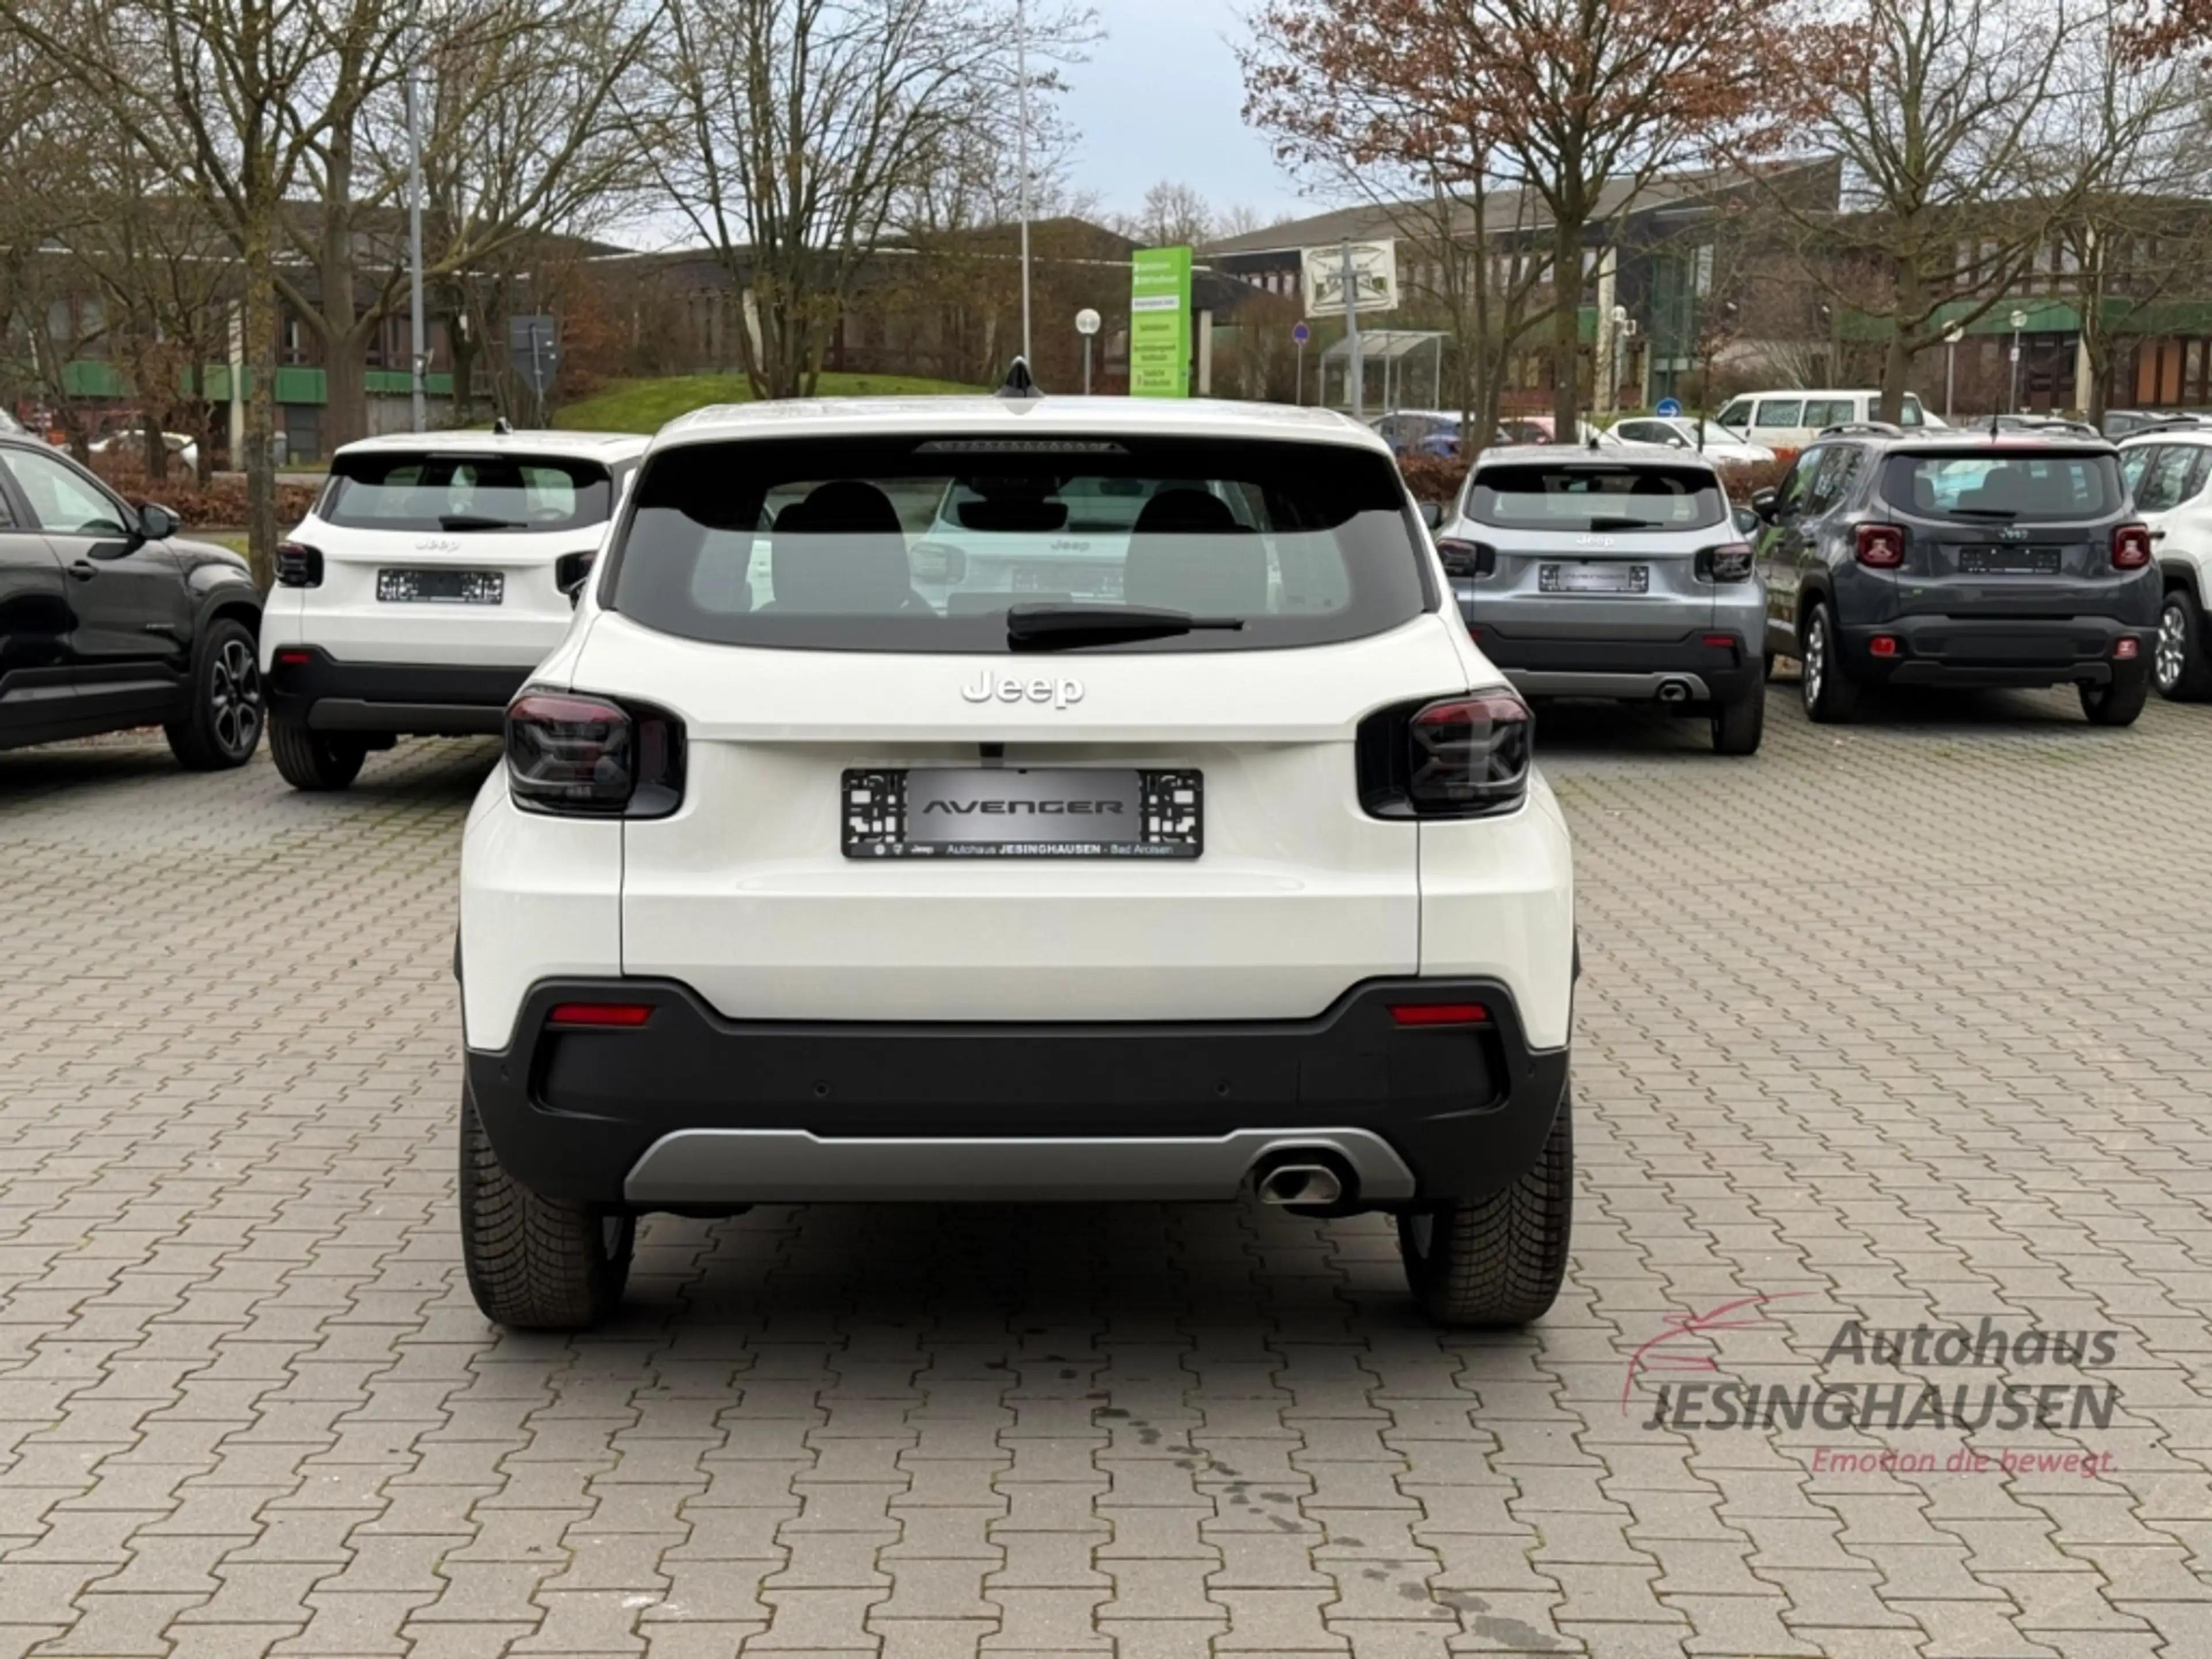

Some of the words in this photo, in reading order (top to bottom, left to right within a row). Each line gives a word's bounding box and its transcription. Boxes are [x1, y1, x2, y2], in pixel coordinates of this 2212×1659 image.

[414, 536, 461, 554] Jeep
[1049, 539, 1091, 552] Jeep
[1576, 535, 1615, 546] Jeep
[961, 670, 1085, 710] Jeep
[922, 800, 1126, 815] AVENGER
[946, 844, 997, 854] Autohaus
[999, 844, 1101, 854] JESINGHAUSEN
[1109, 844, 1131, 854] Bad
